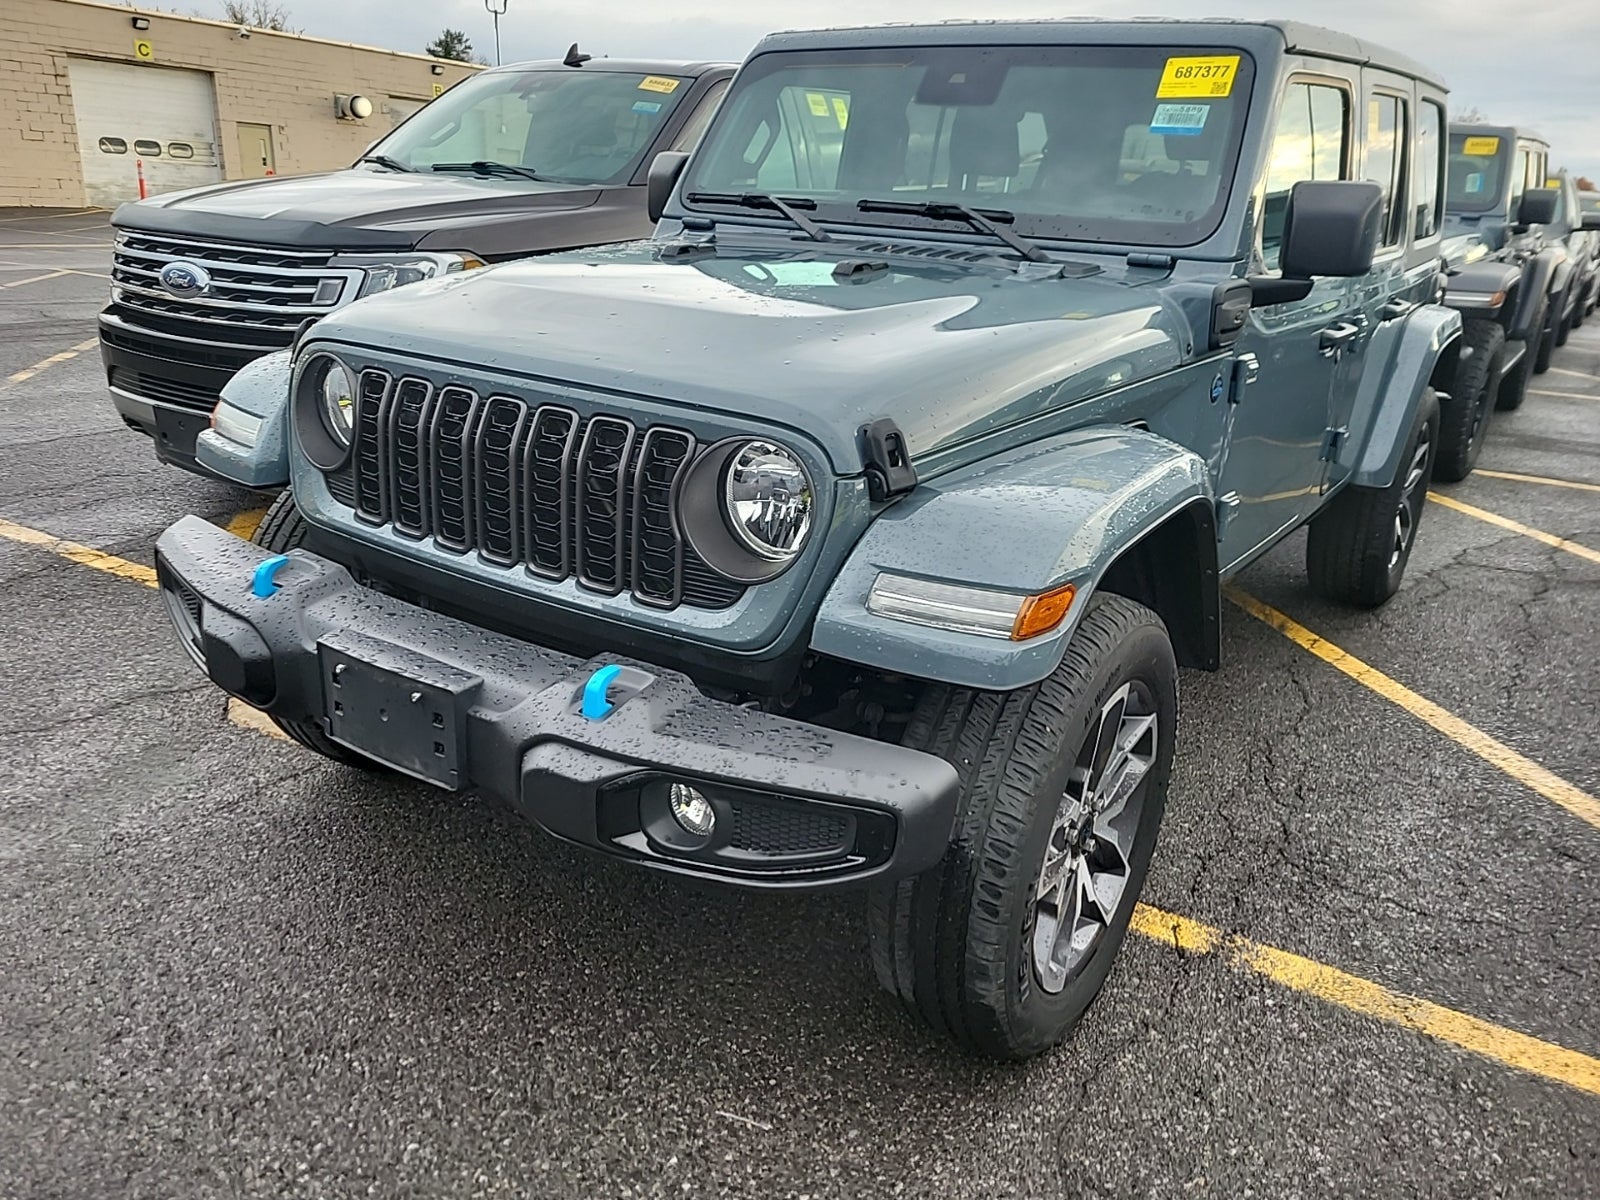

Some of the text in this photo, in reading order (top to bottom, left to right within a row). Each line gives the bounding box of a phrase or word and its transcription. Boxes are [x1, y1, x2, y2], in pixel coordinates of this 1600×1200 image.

[138, 43, 150, 57] C
[1175, 65, 1231, 79] 687377
[166, 269, 191, 288] Ford
